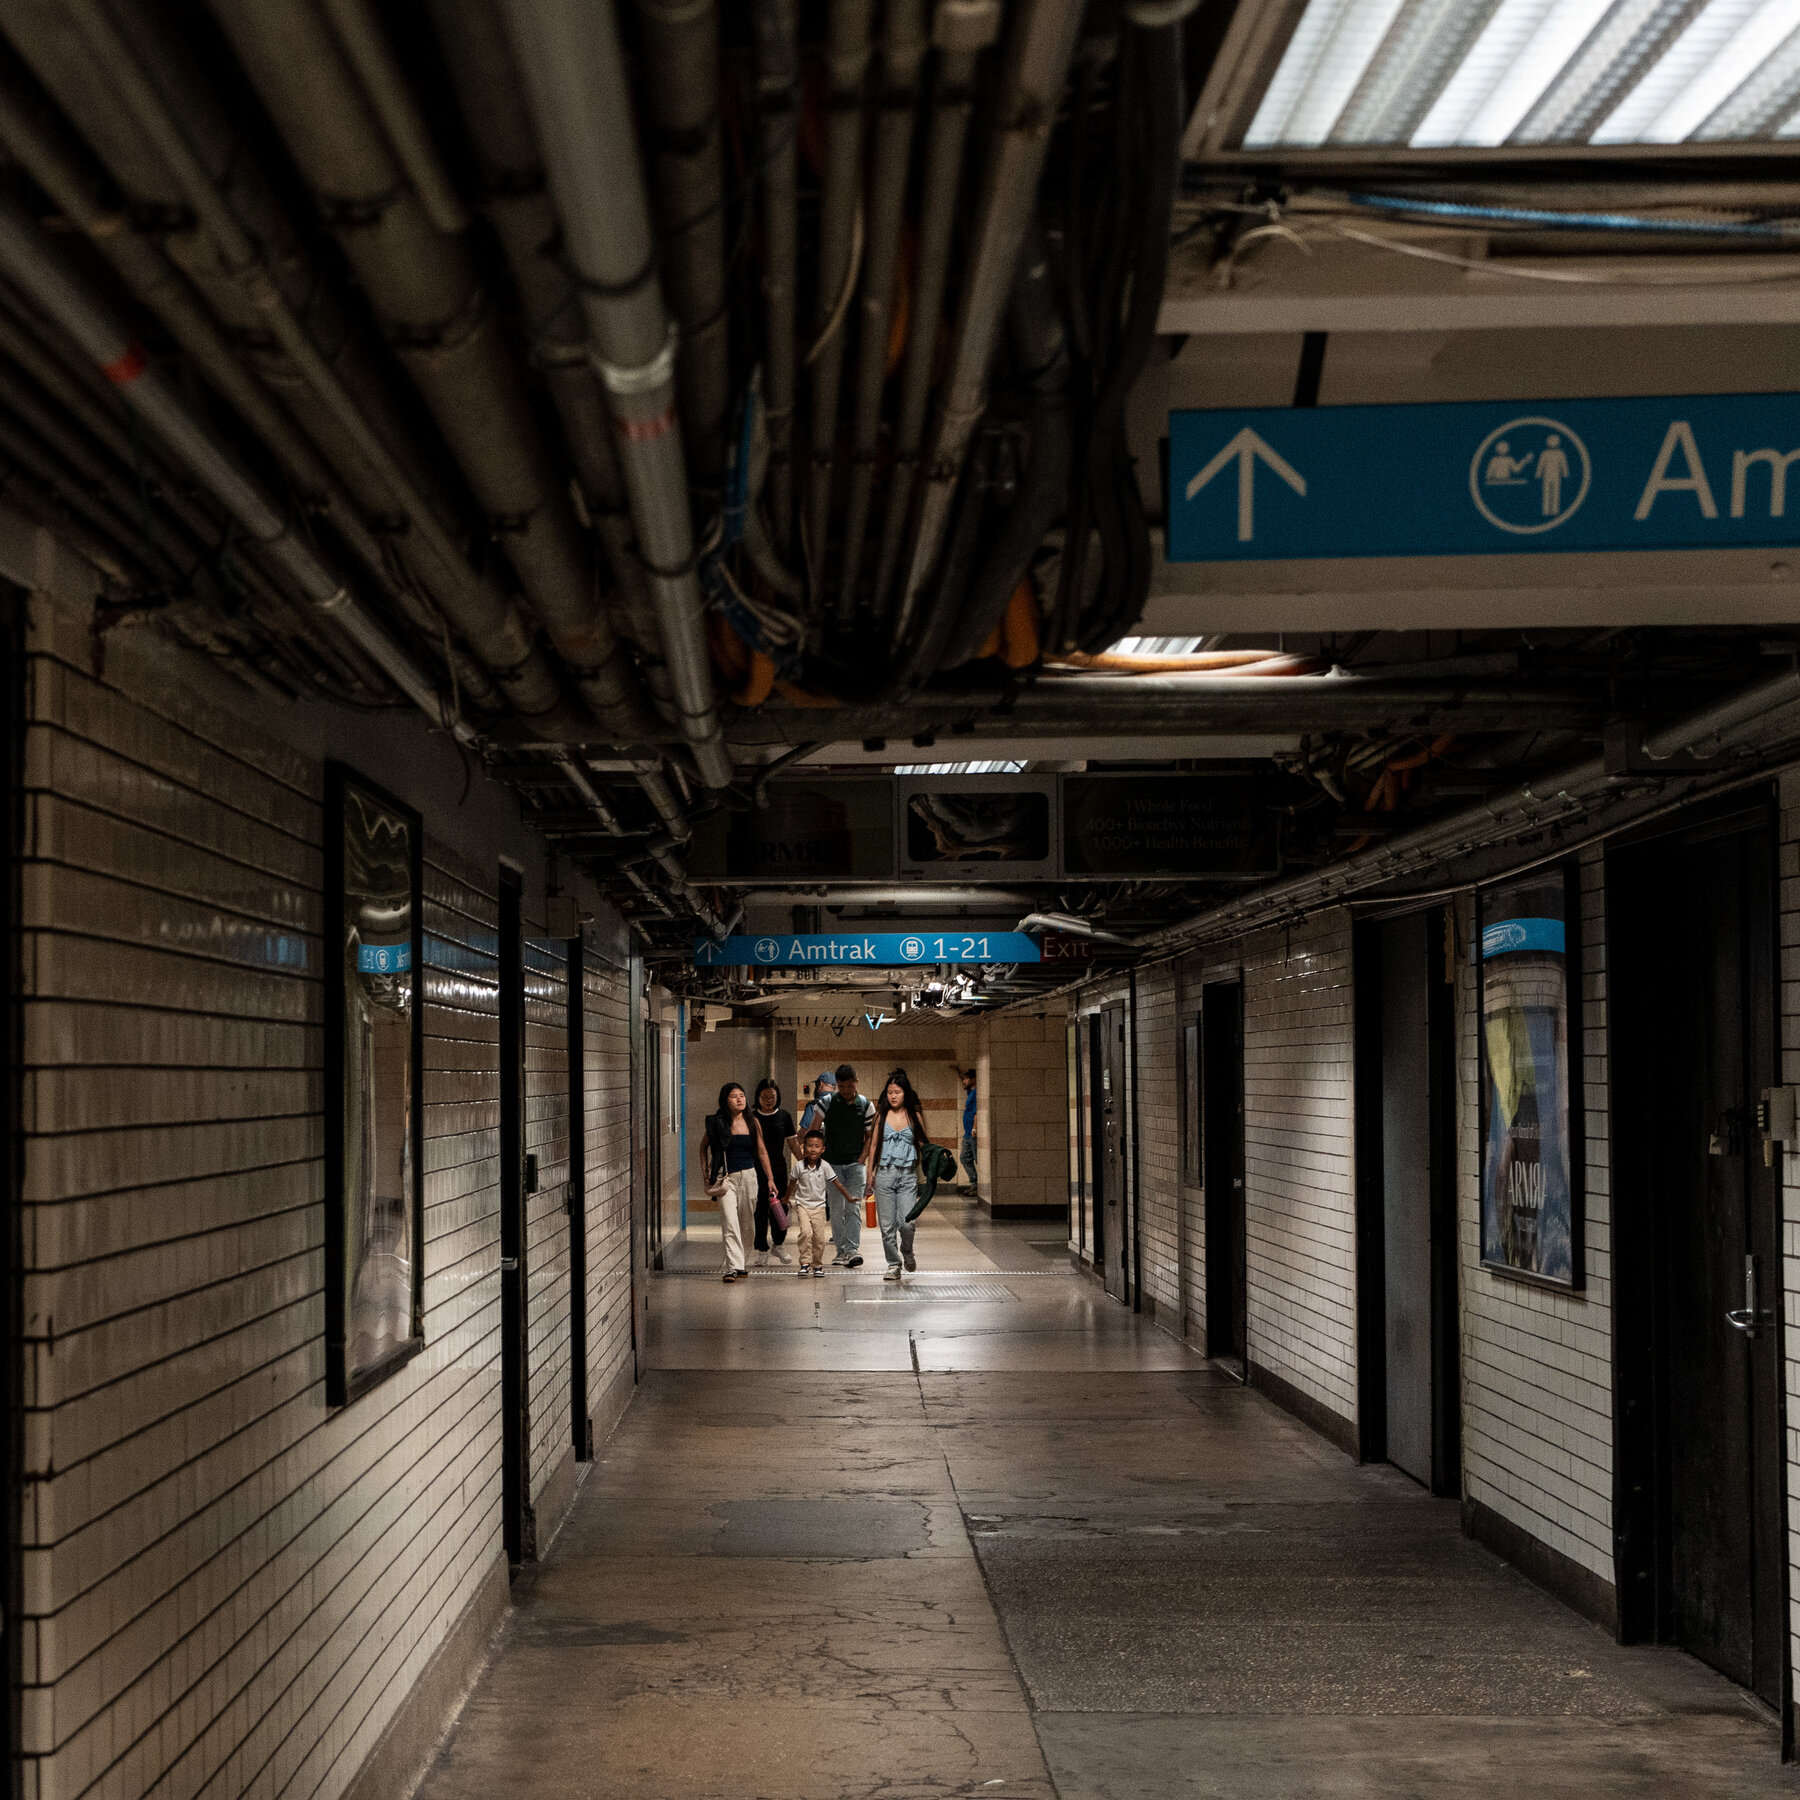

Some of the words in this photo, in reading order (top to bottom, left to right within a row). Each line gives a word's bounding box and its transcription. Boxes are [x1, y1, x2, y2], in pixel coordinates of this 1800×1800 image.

[1133, 798, 1177, 813] Whole
[1180, 798, 1213, 813] Food
[1085, 817, 1124, 831] 400+
[1128, 817, 1187, 831] Bioactive
[1190, 817, 1252, 831] Nutrients
[1145, 835, 1190, 849] Health
[1193, 834, 1248, 849] Benefits
[788, 938, 877, 960] Amtrak
[933, 937, 992, 960] 1-21
[1044, 935, 1091, 958] Exit
